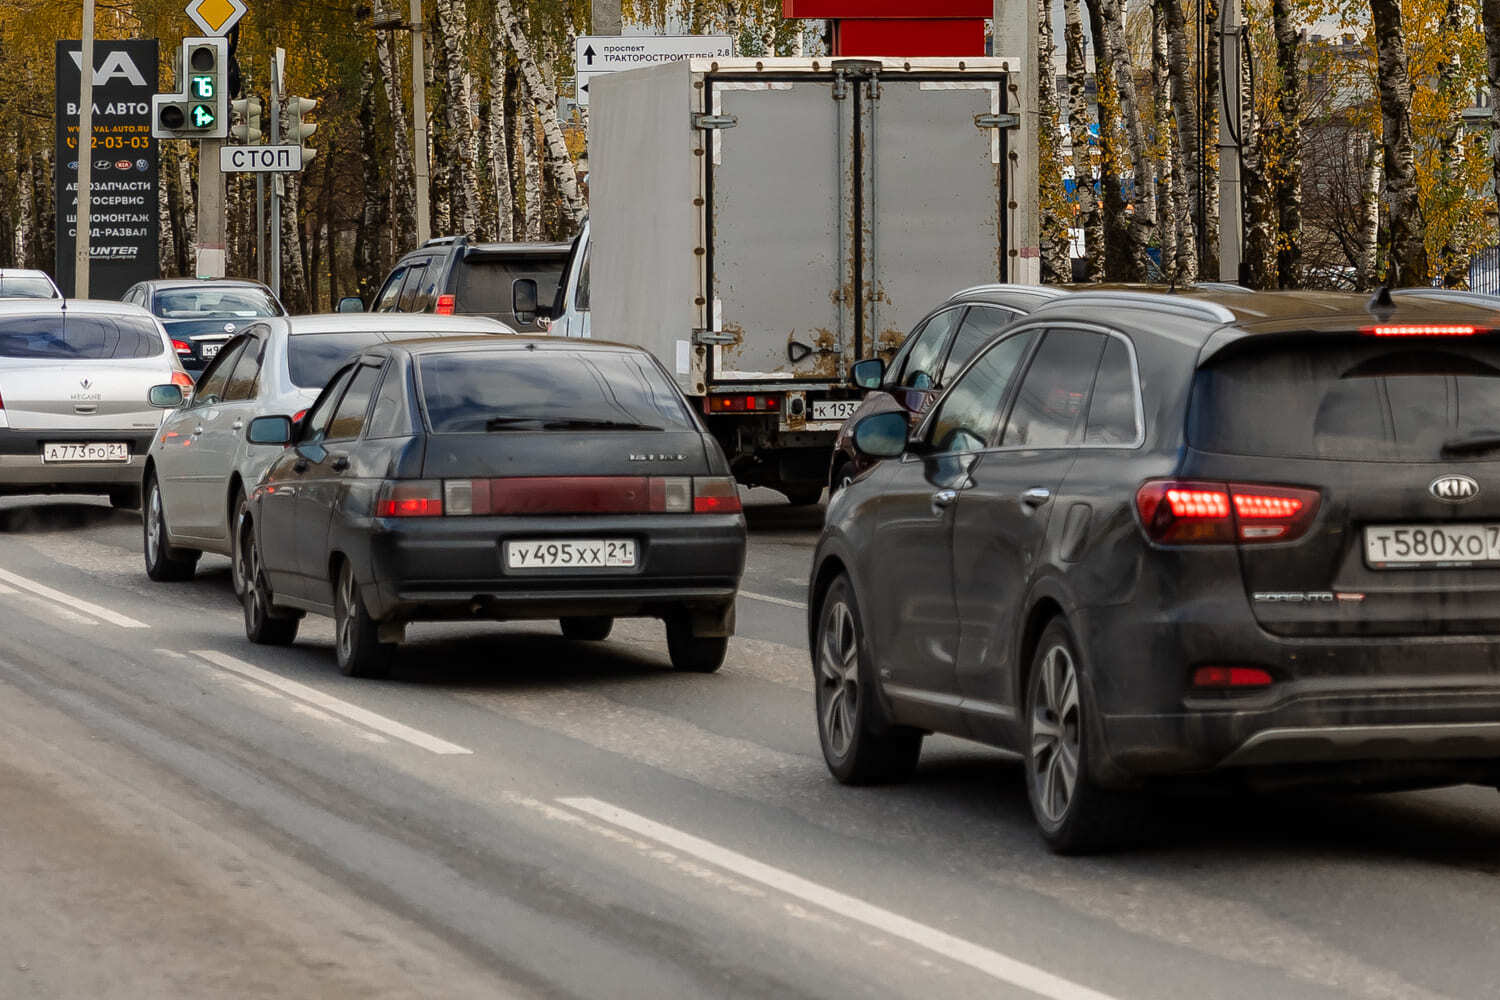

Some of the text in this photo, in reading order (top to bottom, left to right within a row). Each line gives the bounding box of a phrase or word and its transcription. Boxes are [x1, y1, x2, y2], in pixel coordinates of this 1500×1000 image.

[603, 45, 645, 54] проспект
[67, 103, 149, 115] ВЛ АВТО
[90, 137, 150, 149] 2-03-03
[232, 150, 290, 168] СТОП
[65, 182, 151, 191] АВЗАПЧАСТИ
[72, 197, 145, 205] АОСЕРВИС
[66, 214, 150, 223] ШОМОНТАЖ
[68, 228, 147, 237] СД-РАЗВАЛ
[89, 247, 138, 255] UNTER
[1436, 479, 1473, 497] KIA
